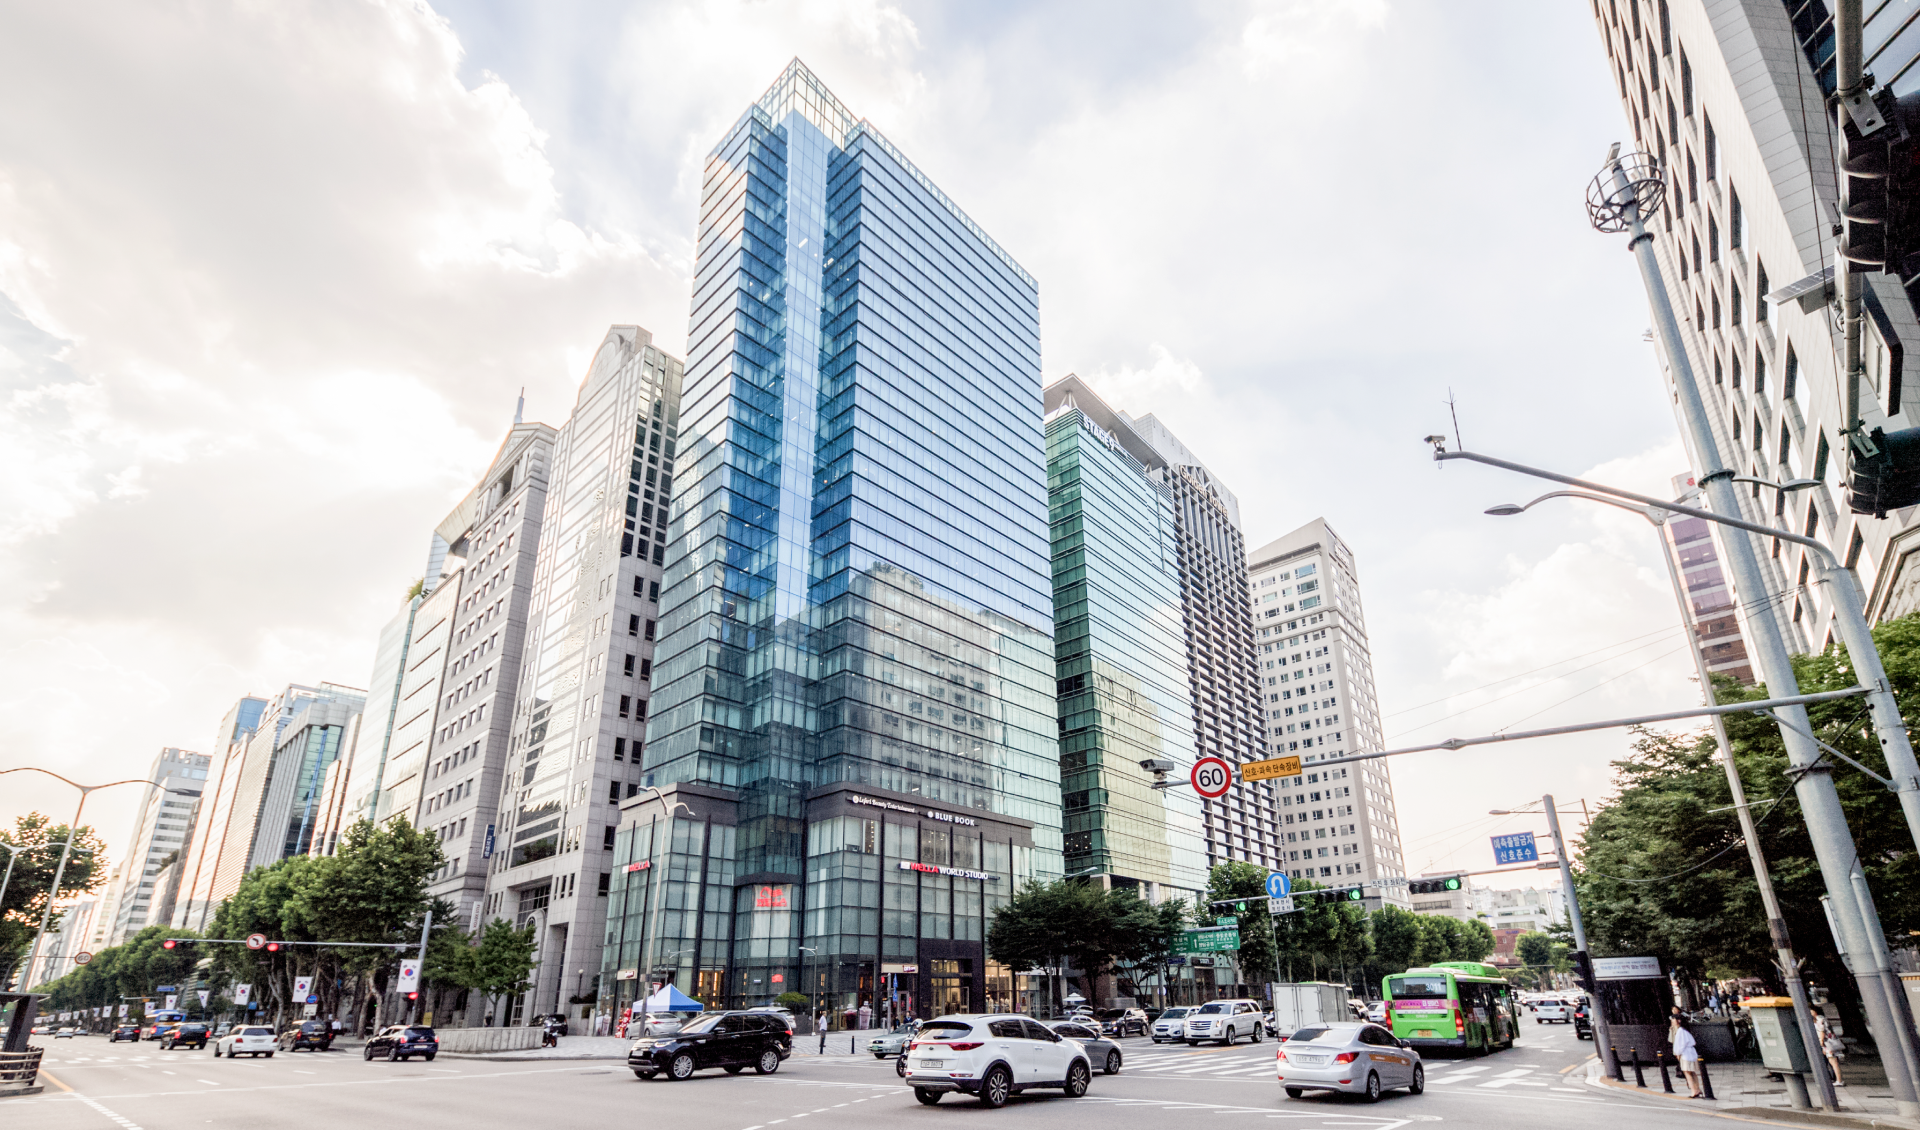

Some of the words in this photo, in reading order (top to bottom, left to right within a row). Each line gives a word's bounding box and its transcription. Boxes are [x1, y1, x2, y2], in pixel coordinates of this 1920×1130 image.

[1179, 464, 1207, 499] Golden
[1206, 490, 1228, 519] Tower
[1272, 761, 1299, 774] 단속장비
[1199, 768, 1224, 787] 60
[935, 812, 953, 822] BLUE
[955, 816, 975, 827] BOOK
[1500, 848, 1532, 863] 신호준수
[910, 862, 939, 874] WELLA
[939, 866, 964, 877] WORLD
[965, 870, 989, 880] STUDIO
[1425, 982, 1442, 991] 3011
